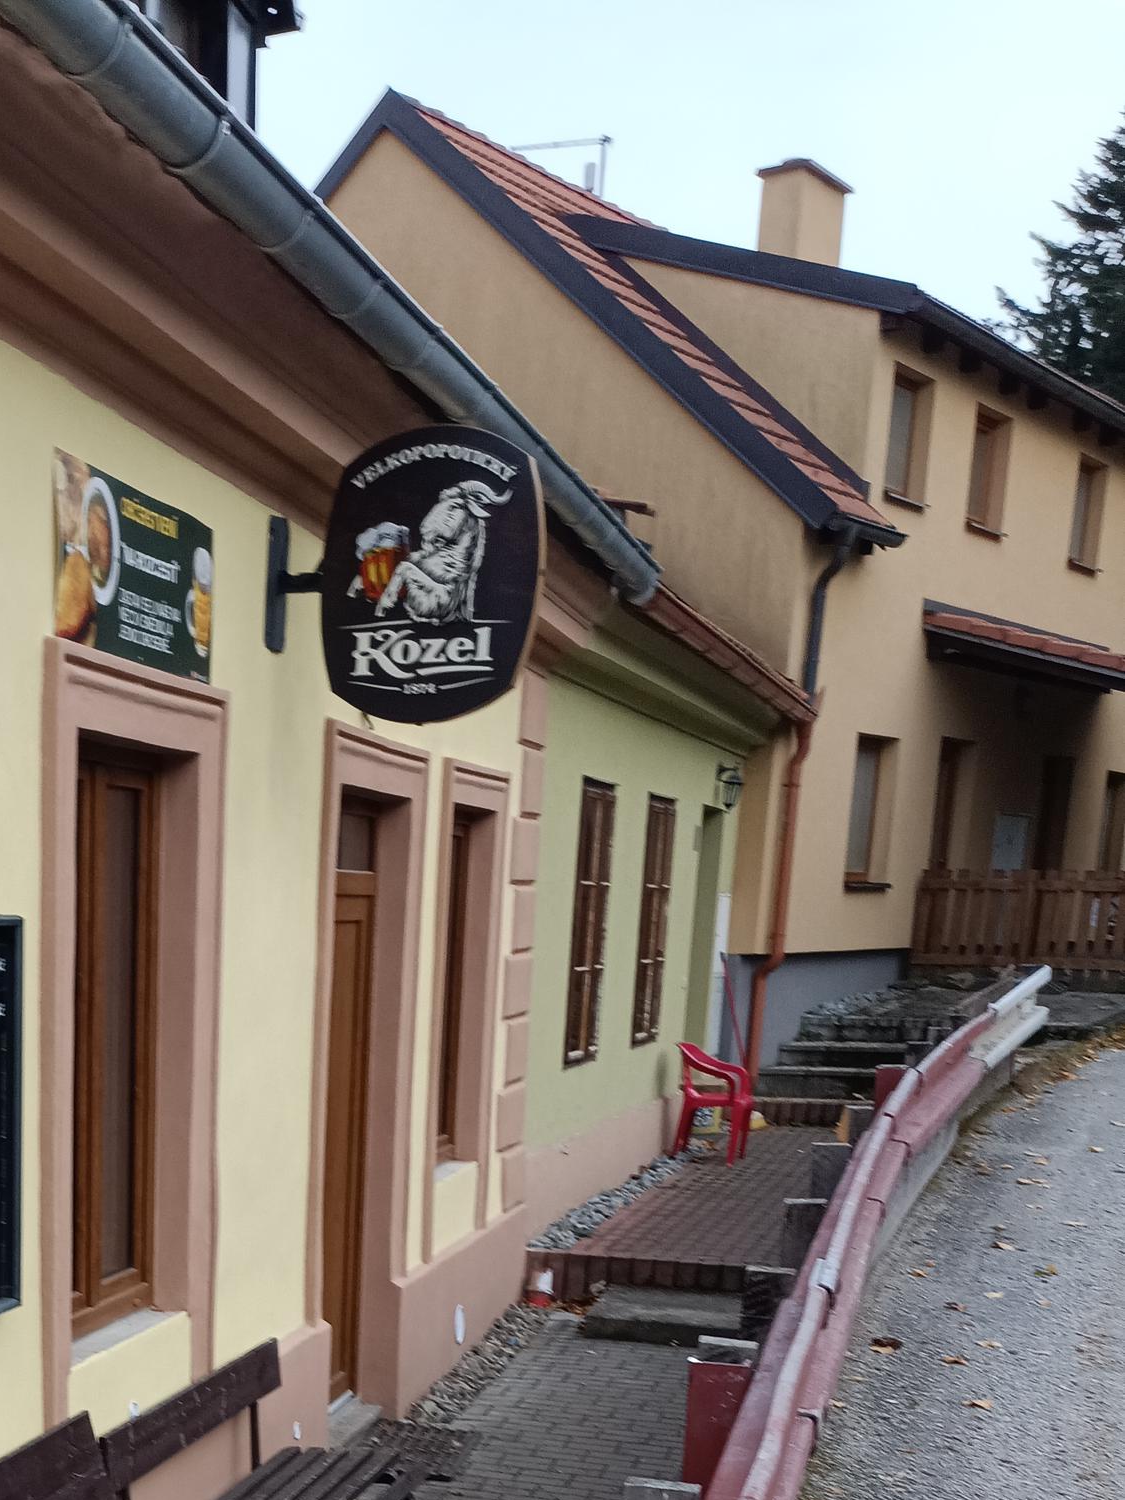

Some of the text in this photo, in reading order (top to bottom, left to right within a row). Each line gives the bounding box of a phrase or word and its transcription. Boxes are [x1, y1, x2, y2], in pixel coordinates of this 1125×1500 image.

[350, 443, 517, 490] VELKOPOPOVICKÝ
[350, 627, 494, 679] Kozel
[402, 682, 437, 695] 1874
